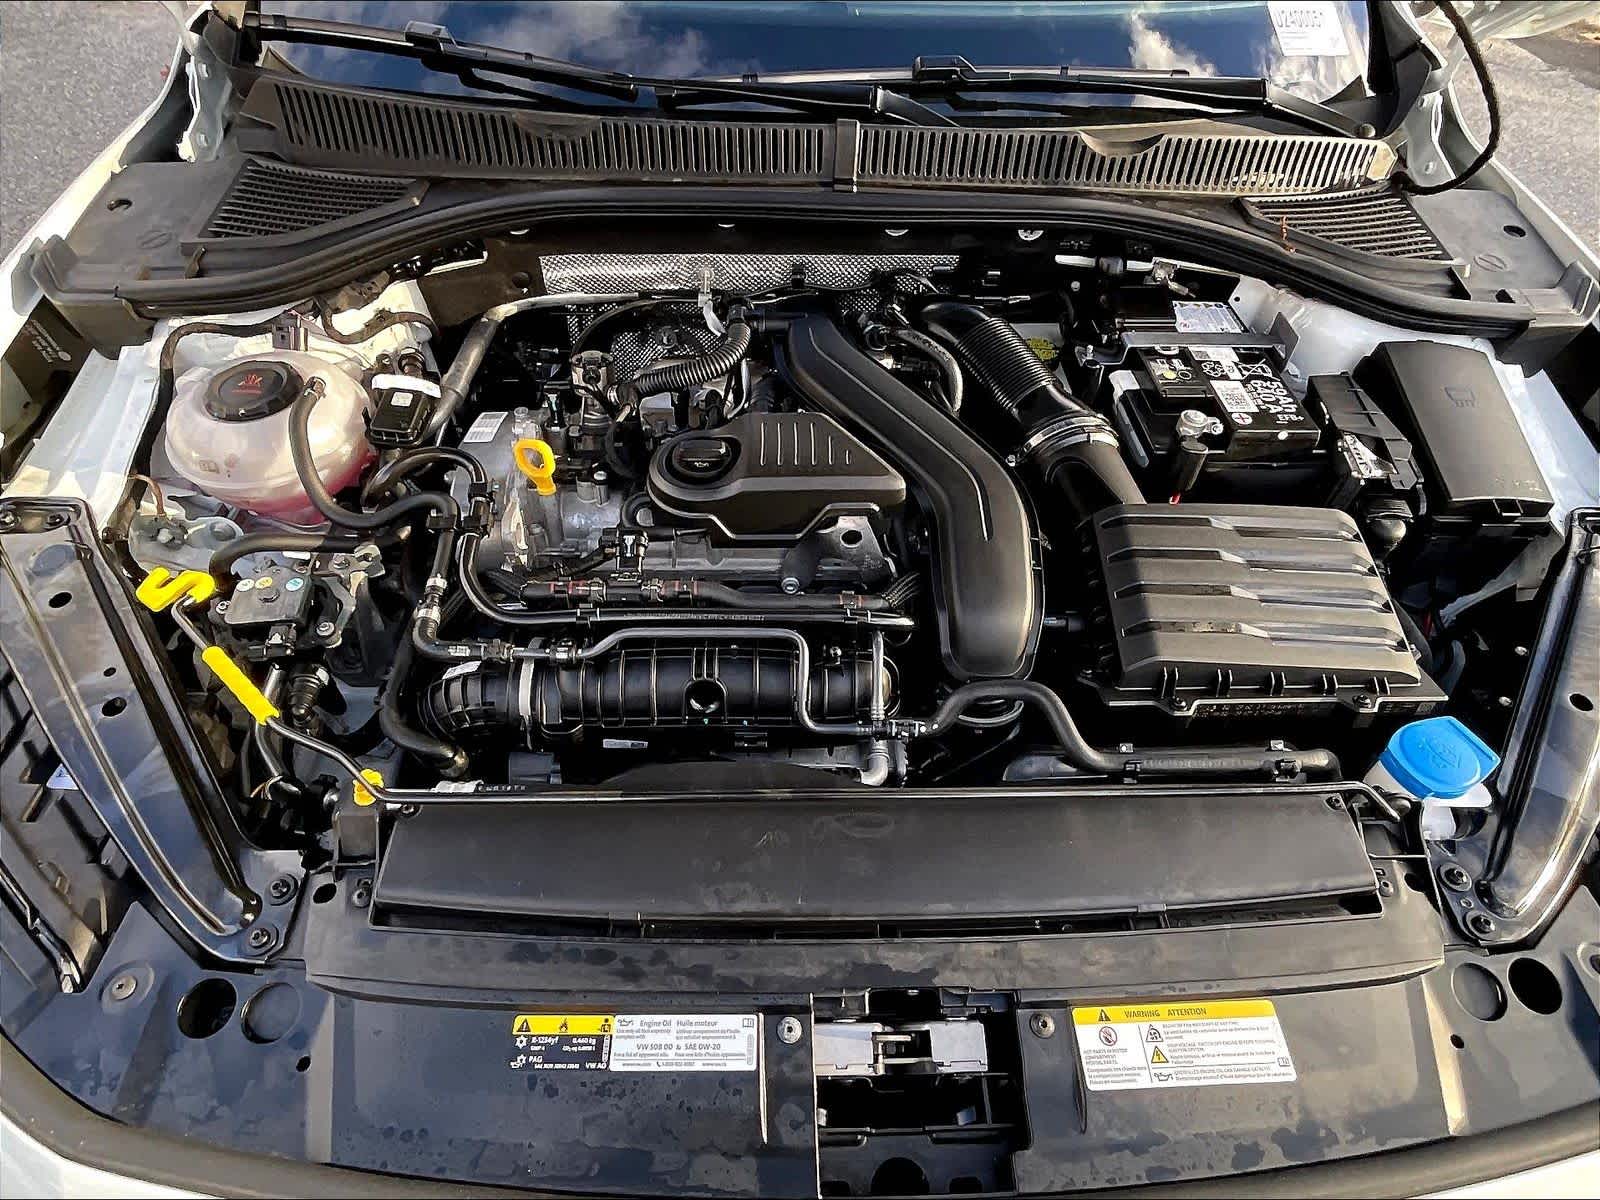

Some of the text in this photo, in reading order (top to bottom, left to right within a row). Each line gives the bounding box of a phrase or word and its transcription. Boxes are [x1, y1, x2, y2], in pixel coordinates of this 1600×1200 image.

[1250, 380, 1276, 403] 640
[1124, 1007, 1207, 1019] WARNING ATTENTION
[640, 1019, 672, 1028] Engine Oil
[676, 1019, 693, 1027] Huile
